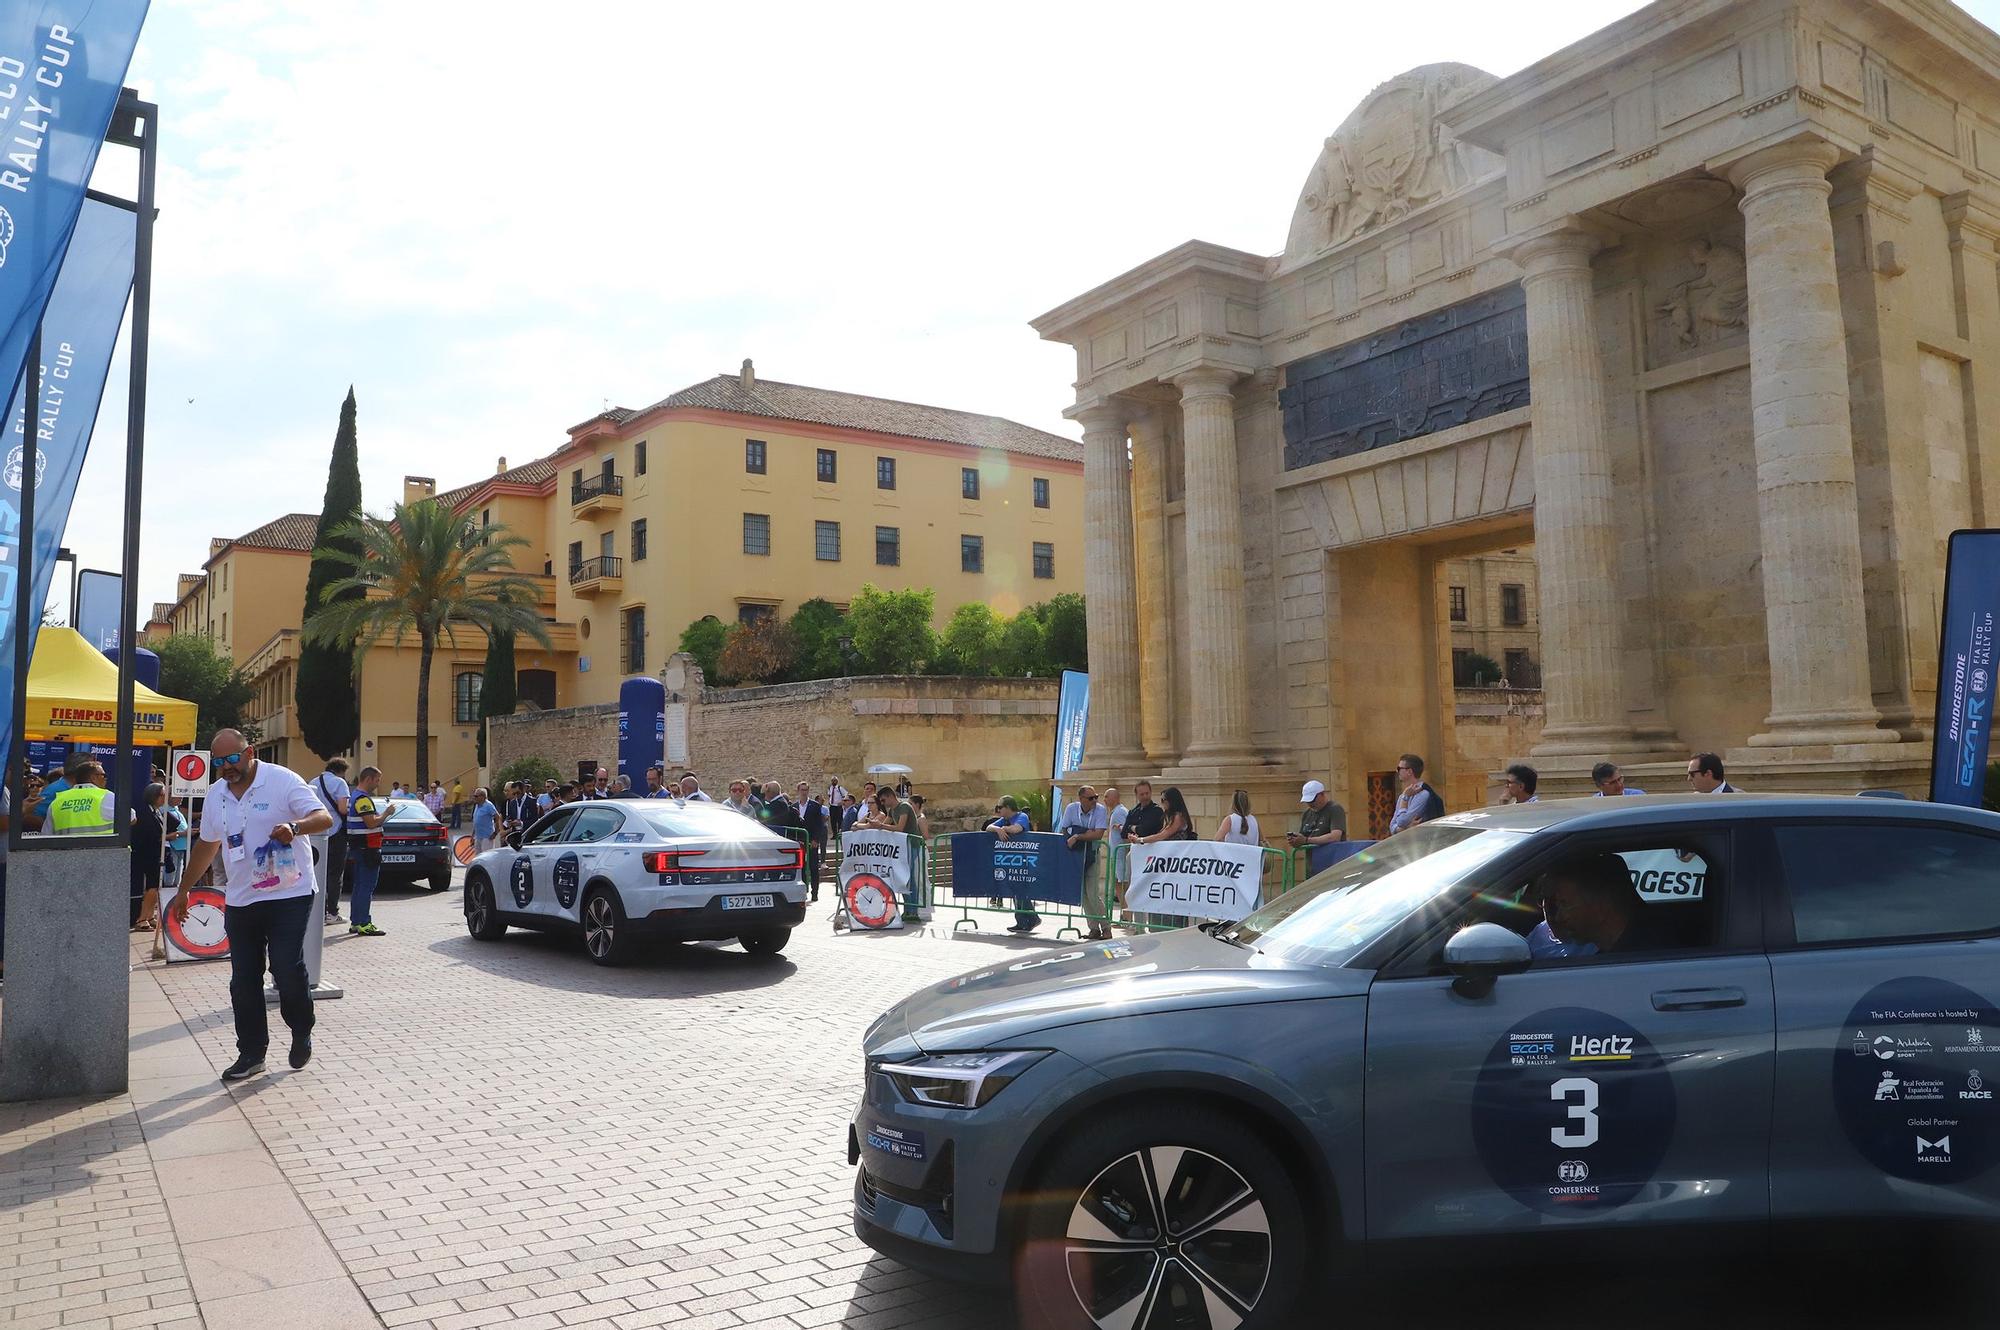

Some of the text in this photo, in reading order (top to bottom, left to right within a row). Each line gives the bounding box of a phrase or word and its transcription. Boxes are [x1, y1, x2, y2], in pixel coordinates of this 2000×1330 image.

[1, 24, 75, 193] RALLY CUP
[37, 342, 75, 441] RALLY CUP
[1973, 626, 1983, 664] FIA ECO
[1981, 612, 1993, 665] RALLY CUP
[1950, 653, 1966, 742] BRIDGESTONE
[51, 707, 113, 721] TIEMPOS
[91, 746, 143, 756] BRIDGENE
[62, 798, 94, 808] ACTION
[73, 805, 91, 813] CAR
[994, 840, 1040, 850] BRIDGESTONE
[1143, 856, 1245, 879] BRIDGESTONE
[518, 871, 525, 891] 2
[665, 875, 673, 884] 2
[1148, 882, 1236, 905] ENLITEN
[729, 896, 772, 907] 5272 MBR
[1871, 1011, 1883, 1019] The
[1885, 1011, 1896, 1019] FIA
[1898, 1010, 1937, 1018] Conference
[1945, 1009, 1967, 1018] hosted
[1968, 1009, 1978, 1019] by
[1570, 1034, 1634, 1055] Hertz
[1959, 1091, 1992, 1099] RACE
[1551, 1077, 1599, 1148] 3
[1907, 1118, 1958, 1126] Global Partner
[1548, 1186, 1600, 1194] CONFERENCE
